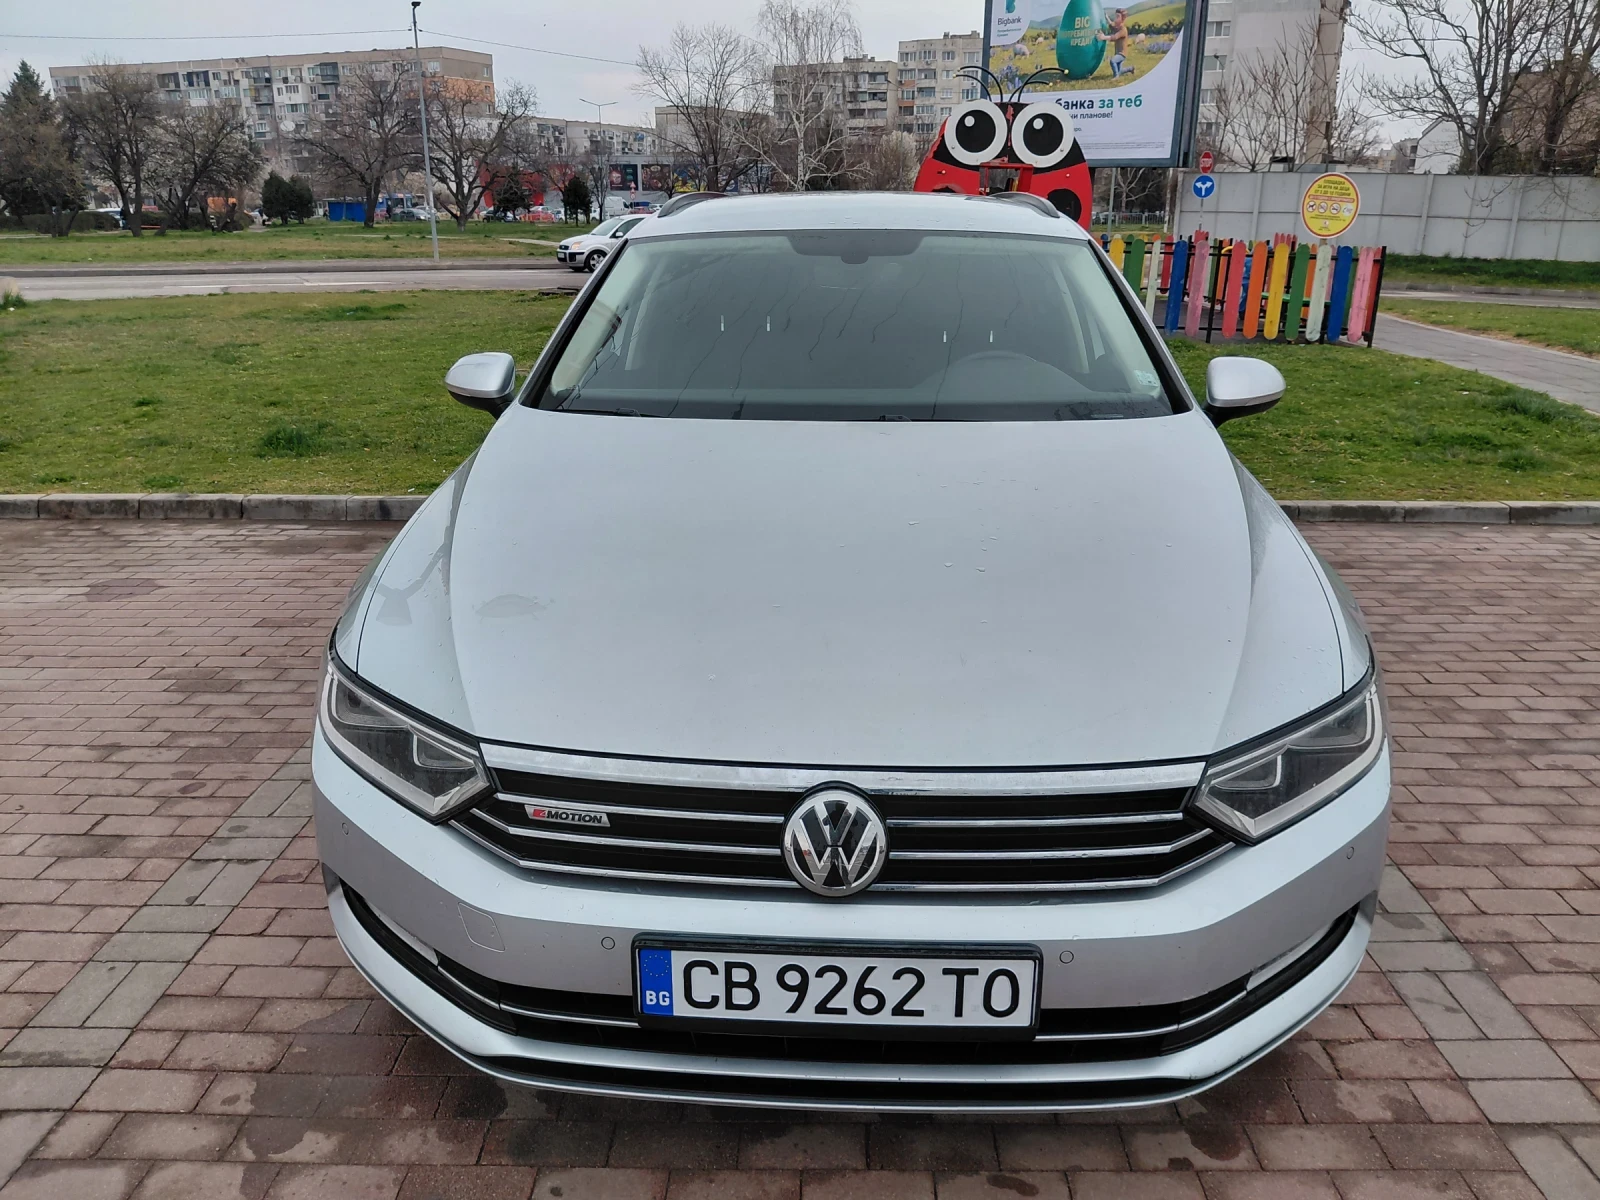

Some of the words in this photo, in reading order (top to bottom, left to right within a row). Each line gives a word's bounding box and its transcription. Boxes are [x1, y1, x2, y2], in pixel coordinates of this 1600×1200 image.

[997, 16, 1022, 27] Bigbank
[1074, 16, 1091, 29] BIG
[1098, 98, 1114, 109] за
[1117, 94, 1143, 108] теб
[1080, 111, 1113, 119] планове!
[1200, 158, 1213, 168] STOP
[683, 959, 761, 1011] CB
[776, 963, 925, 1017] 9262
[645, 990, 670, 1006] BG
